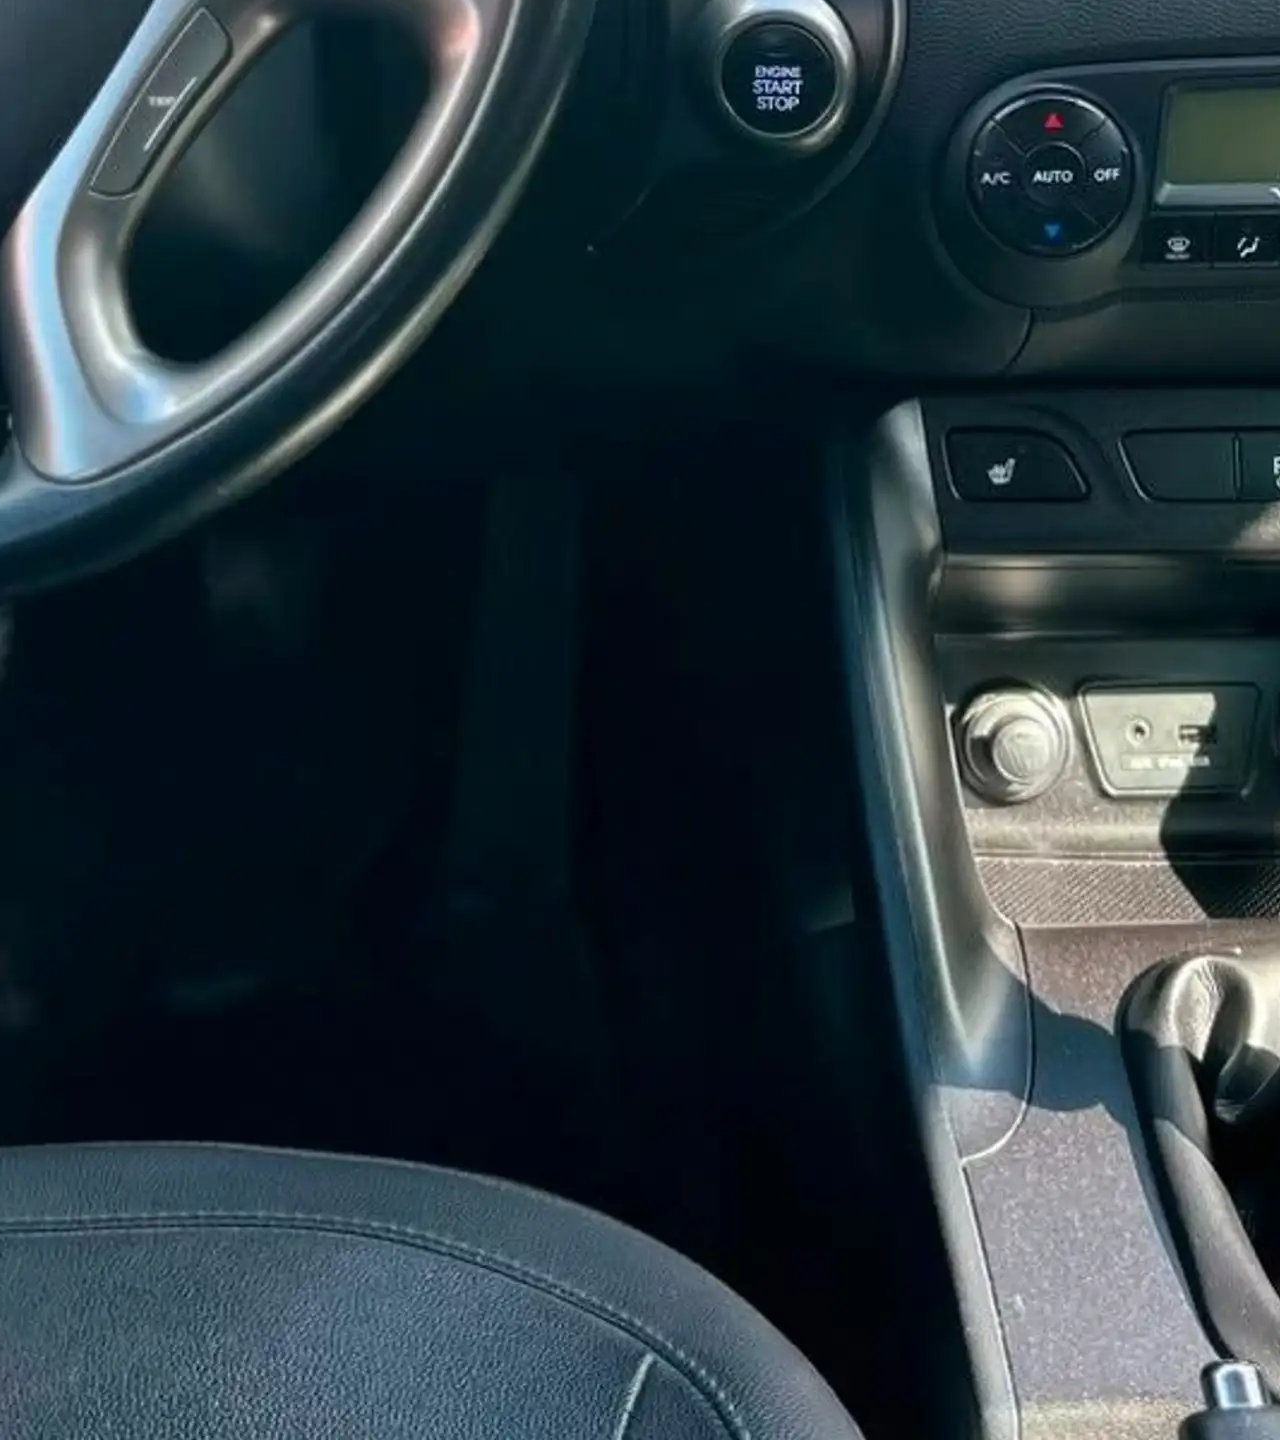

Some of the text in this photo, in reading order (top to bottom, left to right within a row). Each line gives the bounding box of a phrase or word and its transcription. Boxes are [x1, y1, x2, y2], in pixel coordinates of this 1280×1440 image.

[753, 64, 803, 79] ENGINE
[751, 79, 804, 95] START
[755, 95, 801, 112] STOP
[980, 171, 1012, 186] A/C
[1032, 169, 1074, 184] AUTO
[1093, 167, 1121, 182] OFF
